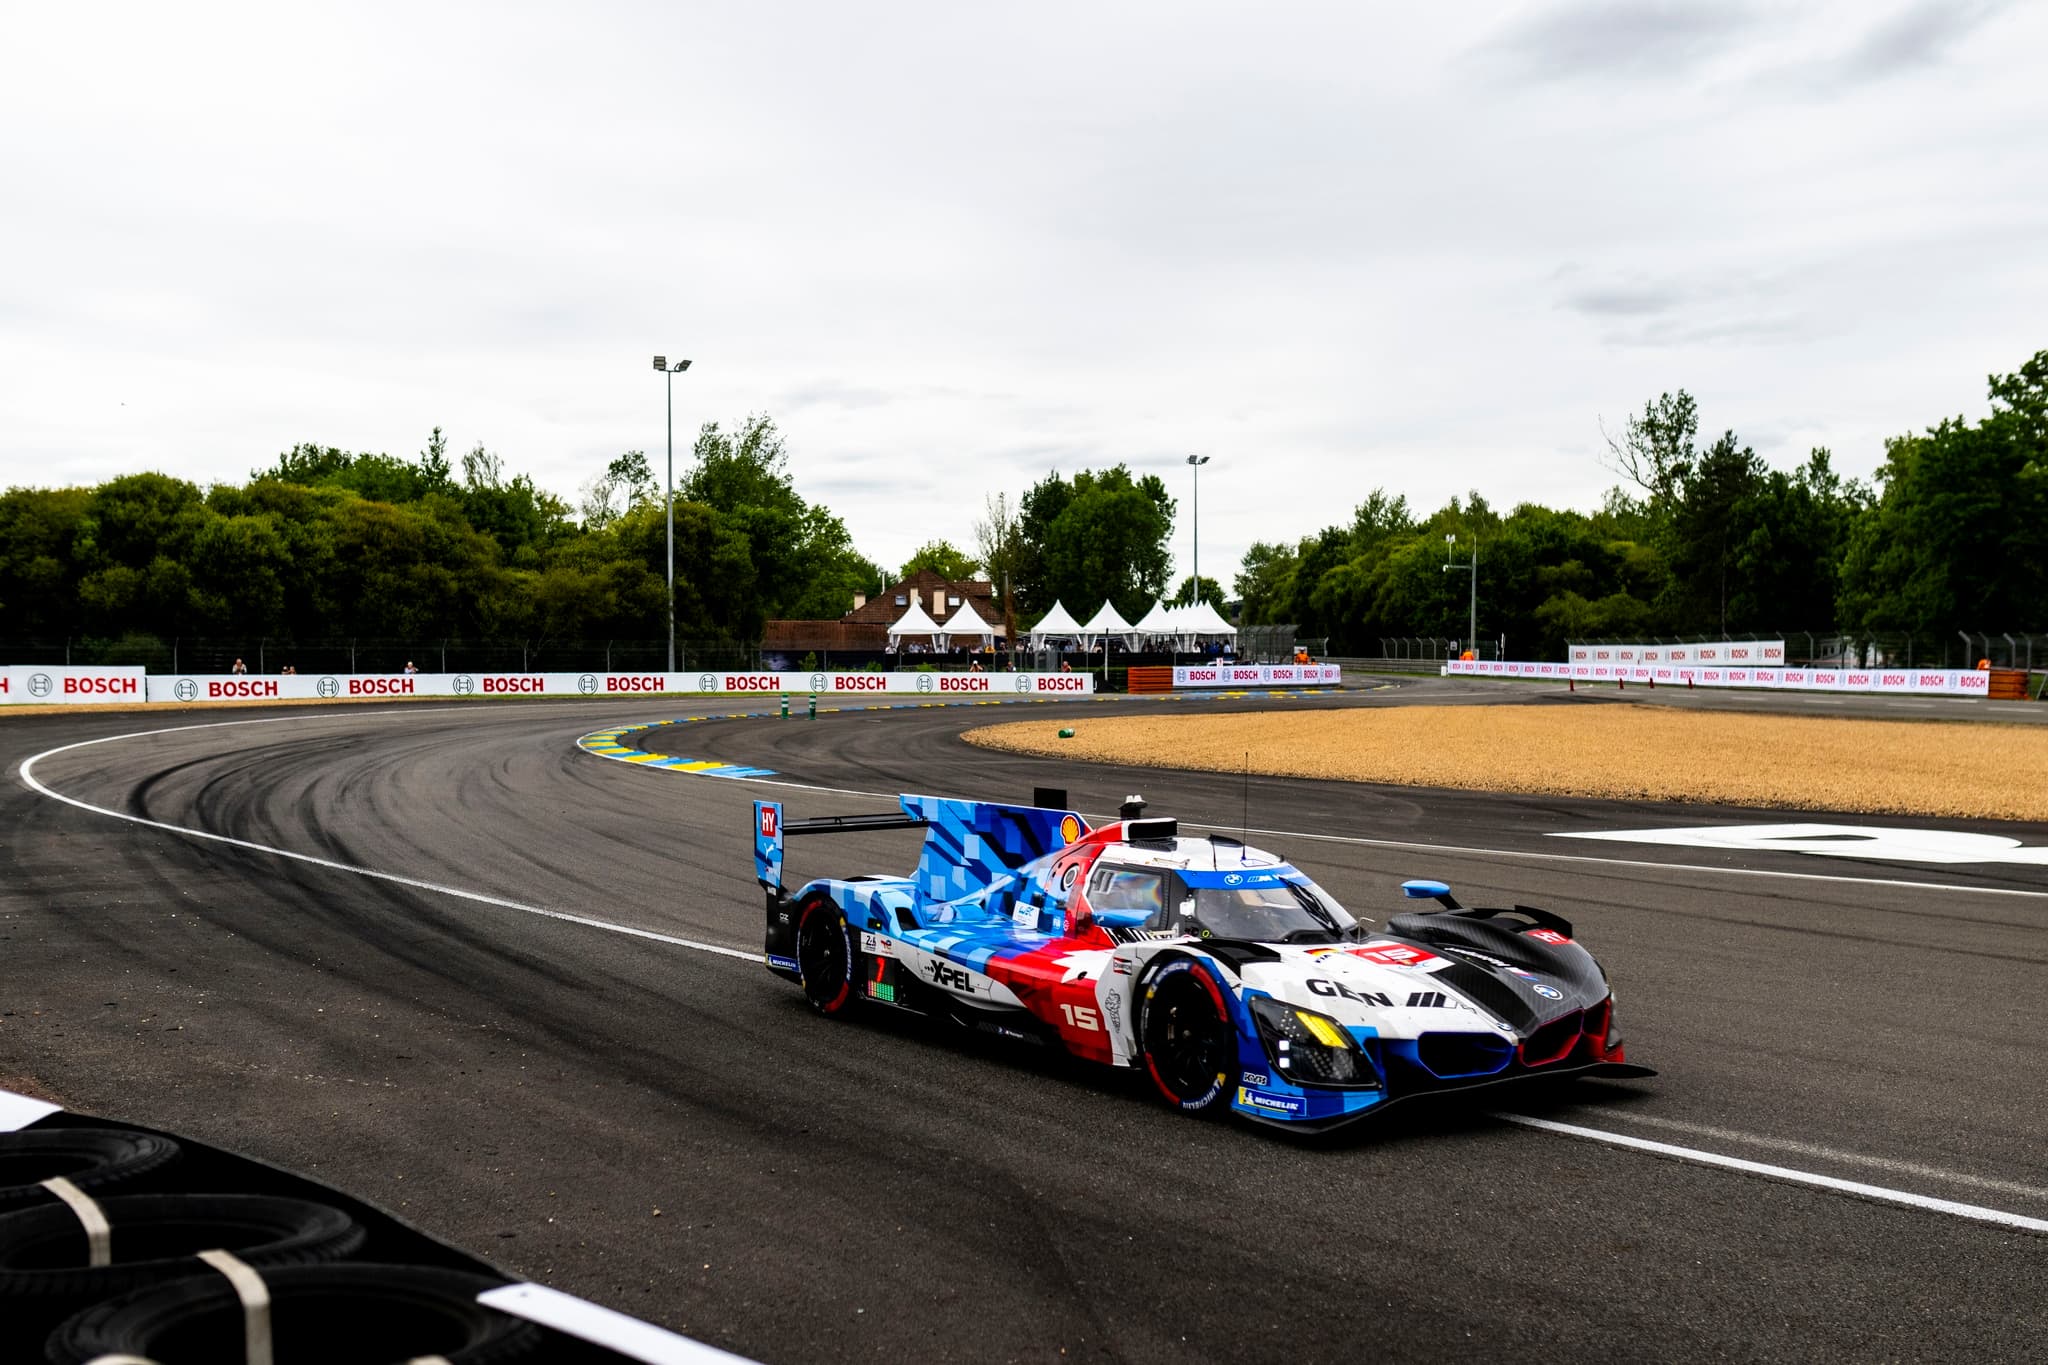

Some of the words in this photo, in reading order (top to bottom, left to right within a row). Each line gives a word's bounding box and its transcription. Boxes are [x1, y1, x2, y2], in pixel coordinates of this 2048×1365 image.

[1189, 671, 1217, 681] BOSCH
[1233, 670, 1259, 680] BOSCH
[1272, 669, 1294, 679] BOSCH
[1784, 672, 1804, 683] BOSCH
[1815, 673, 1836, 684] BOSCH
[1848, 674, 1869, 685] BOSCH
[1882, 675, 1905, 686] BOSCH
[1919, 675, 1945, 687] BOSCH
[63, 676, 137, 695] BOSCH
[208, 680, 279, 698] BOSCH
[348, 678, 415, 695] BOSCH
[482, 677, 545, 693] BOSCH
[606, 676, 665, 693] BOSCH
[725, 675, 781, 691] BOSCH
[834, 675, 887, 691] BOSCH
[939, 677, 989, 692] BOSCH
[1037, 677, 1084, 692] BOSCH
[1960, 676, 1986, 688] BOSCH
[761, 811, 775, 832] HY
[1533, 931, 1568, 943] HY
[1363, 948, 1420, 961] 15
[930, 959, 975, 994] XPEL
[1305, 978, 1395, 1008] GEN
[1060, 1003, 1100, 1032] 15
[1254, 1096, 1299, 1110] MICHELIN
